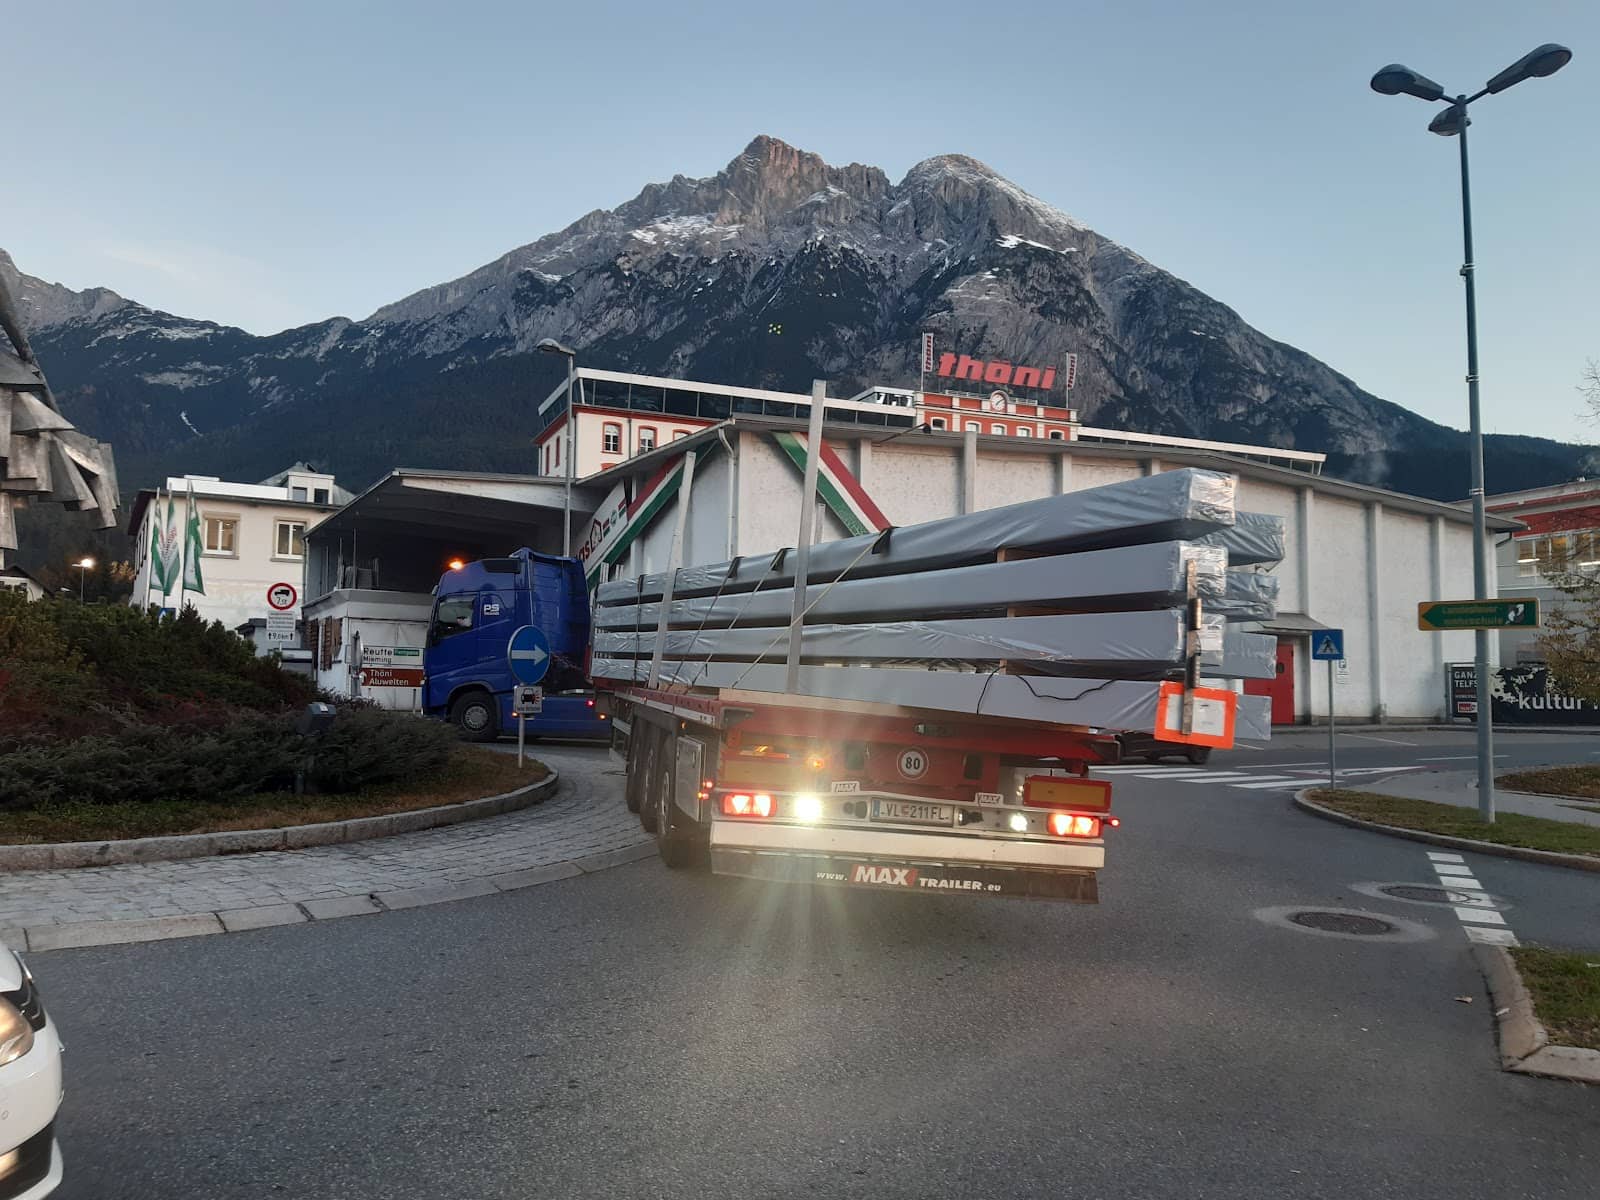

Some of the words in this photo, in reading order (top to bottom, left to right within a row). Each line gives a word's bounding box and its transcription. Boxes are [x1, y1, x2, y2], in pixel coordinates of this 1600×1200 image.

[1519, 690, 1586, 710] kultur
[905, 756, 921, 770] 80
[855, 865, 910, 886] MAX
